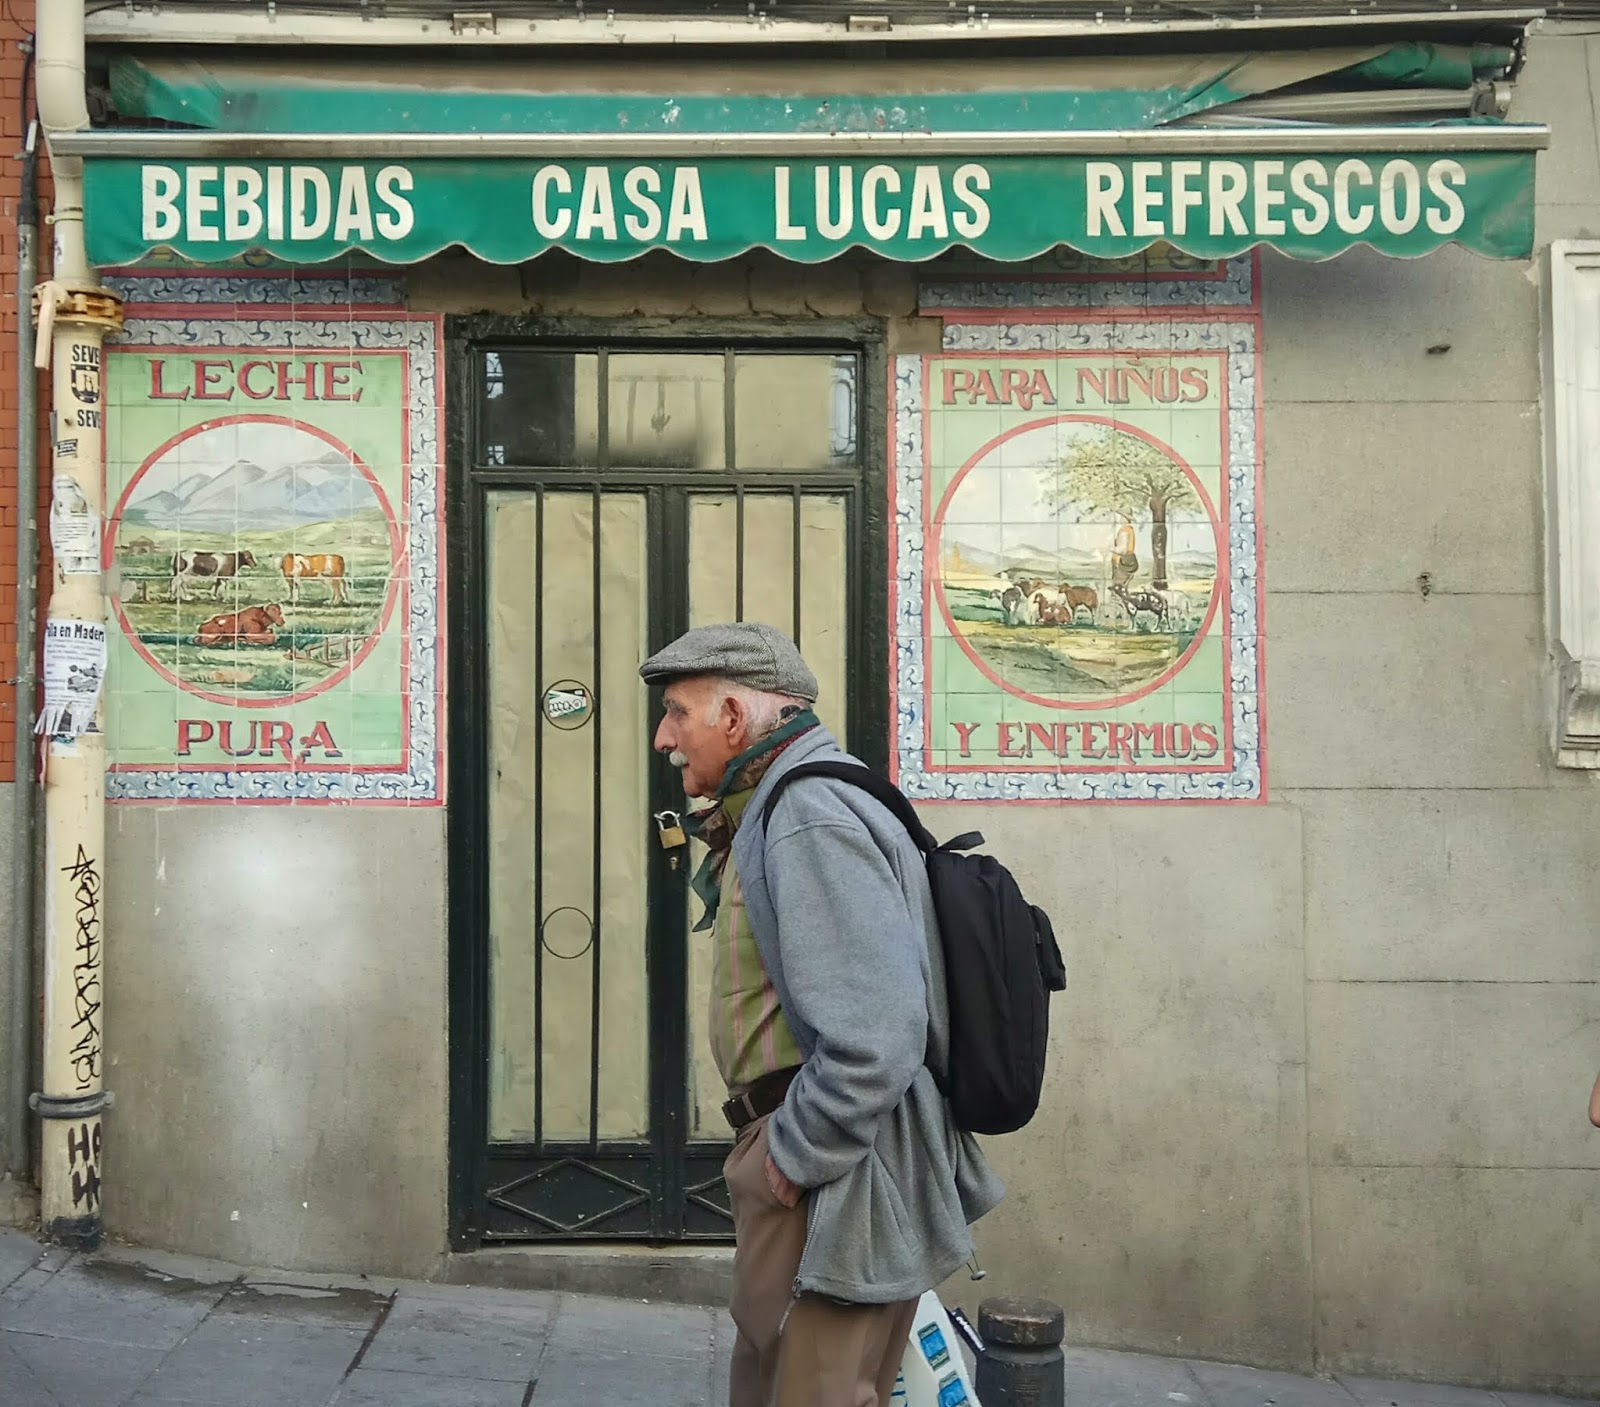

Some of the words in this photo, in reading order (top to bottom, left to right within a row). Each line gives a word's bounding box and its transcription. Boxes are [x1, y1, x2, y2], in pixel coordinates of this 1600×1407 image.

[142, 164, 414, 242] BEBIDAS
[531, 164, 708, 241] CASA
[774, 163, 991, 240] LUCAS
[1086, 159, 1467, 237] REFRESCOS
[147, 359, 364, 402] LECHE
[941, 368, 1057, 411] PARA
[1075, 357, 1209, 405] NIÑOS
[60, 626, 71, 637] en
[174, 720, 343, 765] PURA
[950, 722, 981, 758] Y
[996, 721, 1220, 766] ENFERMOS
